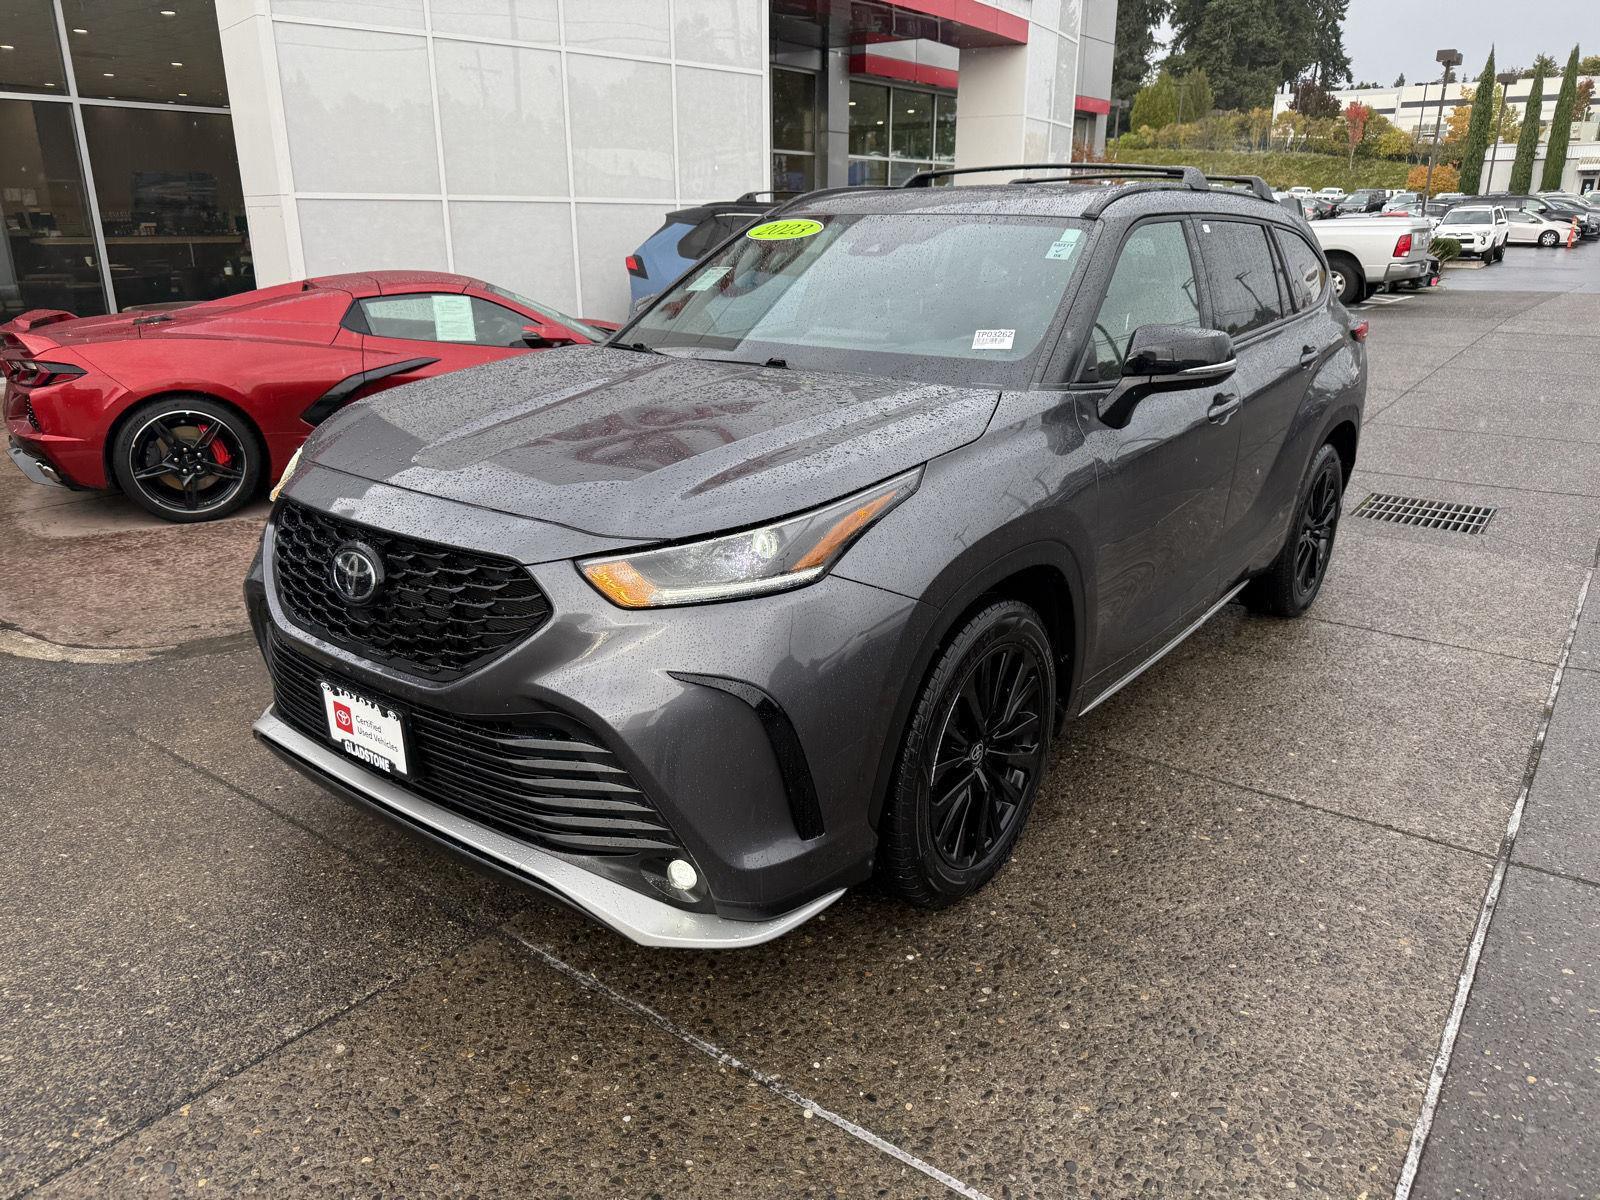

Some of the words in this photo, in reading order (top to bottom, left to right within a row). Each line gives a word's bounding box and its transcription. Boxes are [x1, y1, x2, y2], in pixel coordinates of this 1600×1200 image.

[754, 224, 814, 236] 2023
[355, 715, 382, 733] Certified
[357, 726, 373, 740] Used
[373, 732, 399, 753] Vehicles
[344, 740, 391, 773] GLADSTONE
